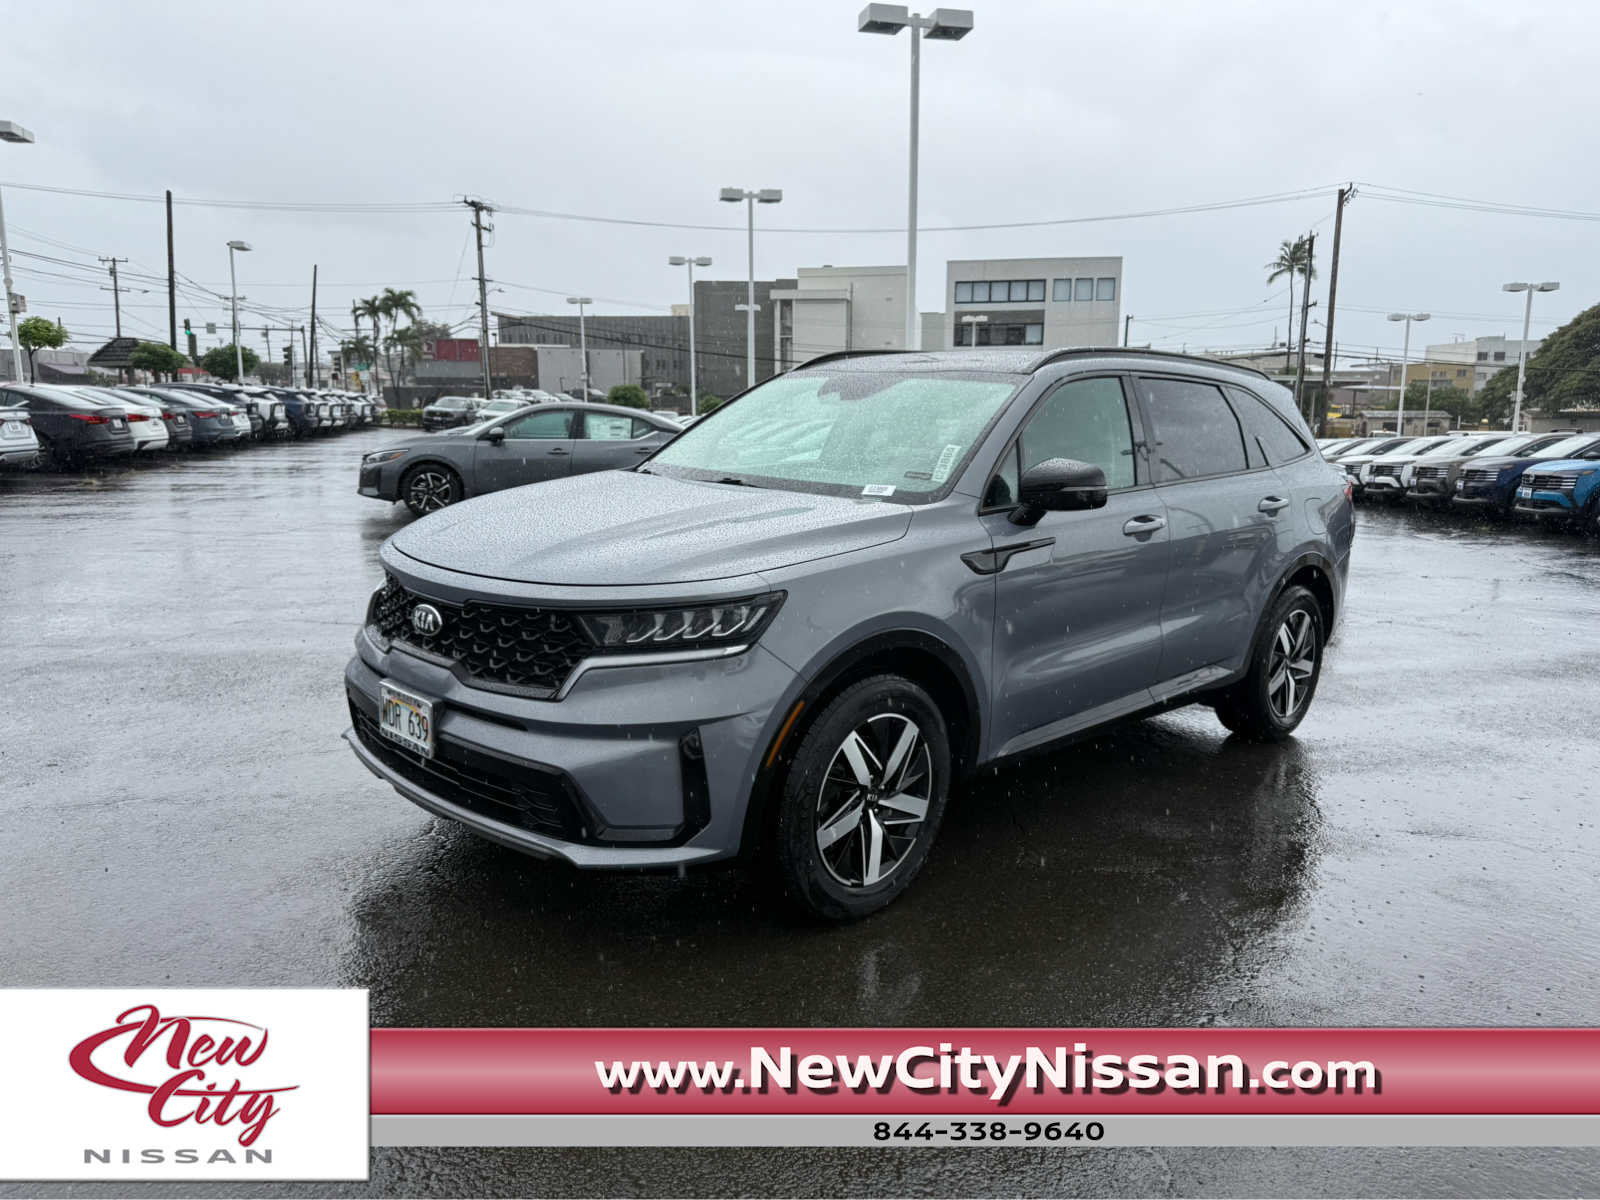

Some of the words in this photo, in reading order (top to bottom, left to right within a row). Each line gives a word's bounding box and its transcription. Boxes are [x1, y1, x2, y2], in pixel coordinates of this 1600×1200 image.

[413, 603, 435, 632] KIA
[408, 710, 429, 742] 639
[381, 728, 430, 757] NISSAN
